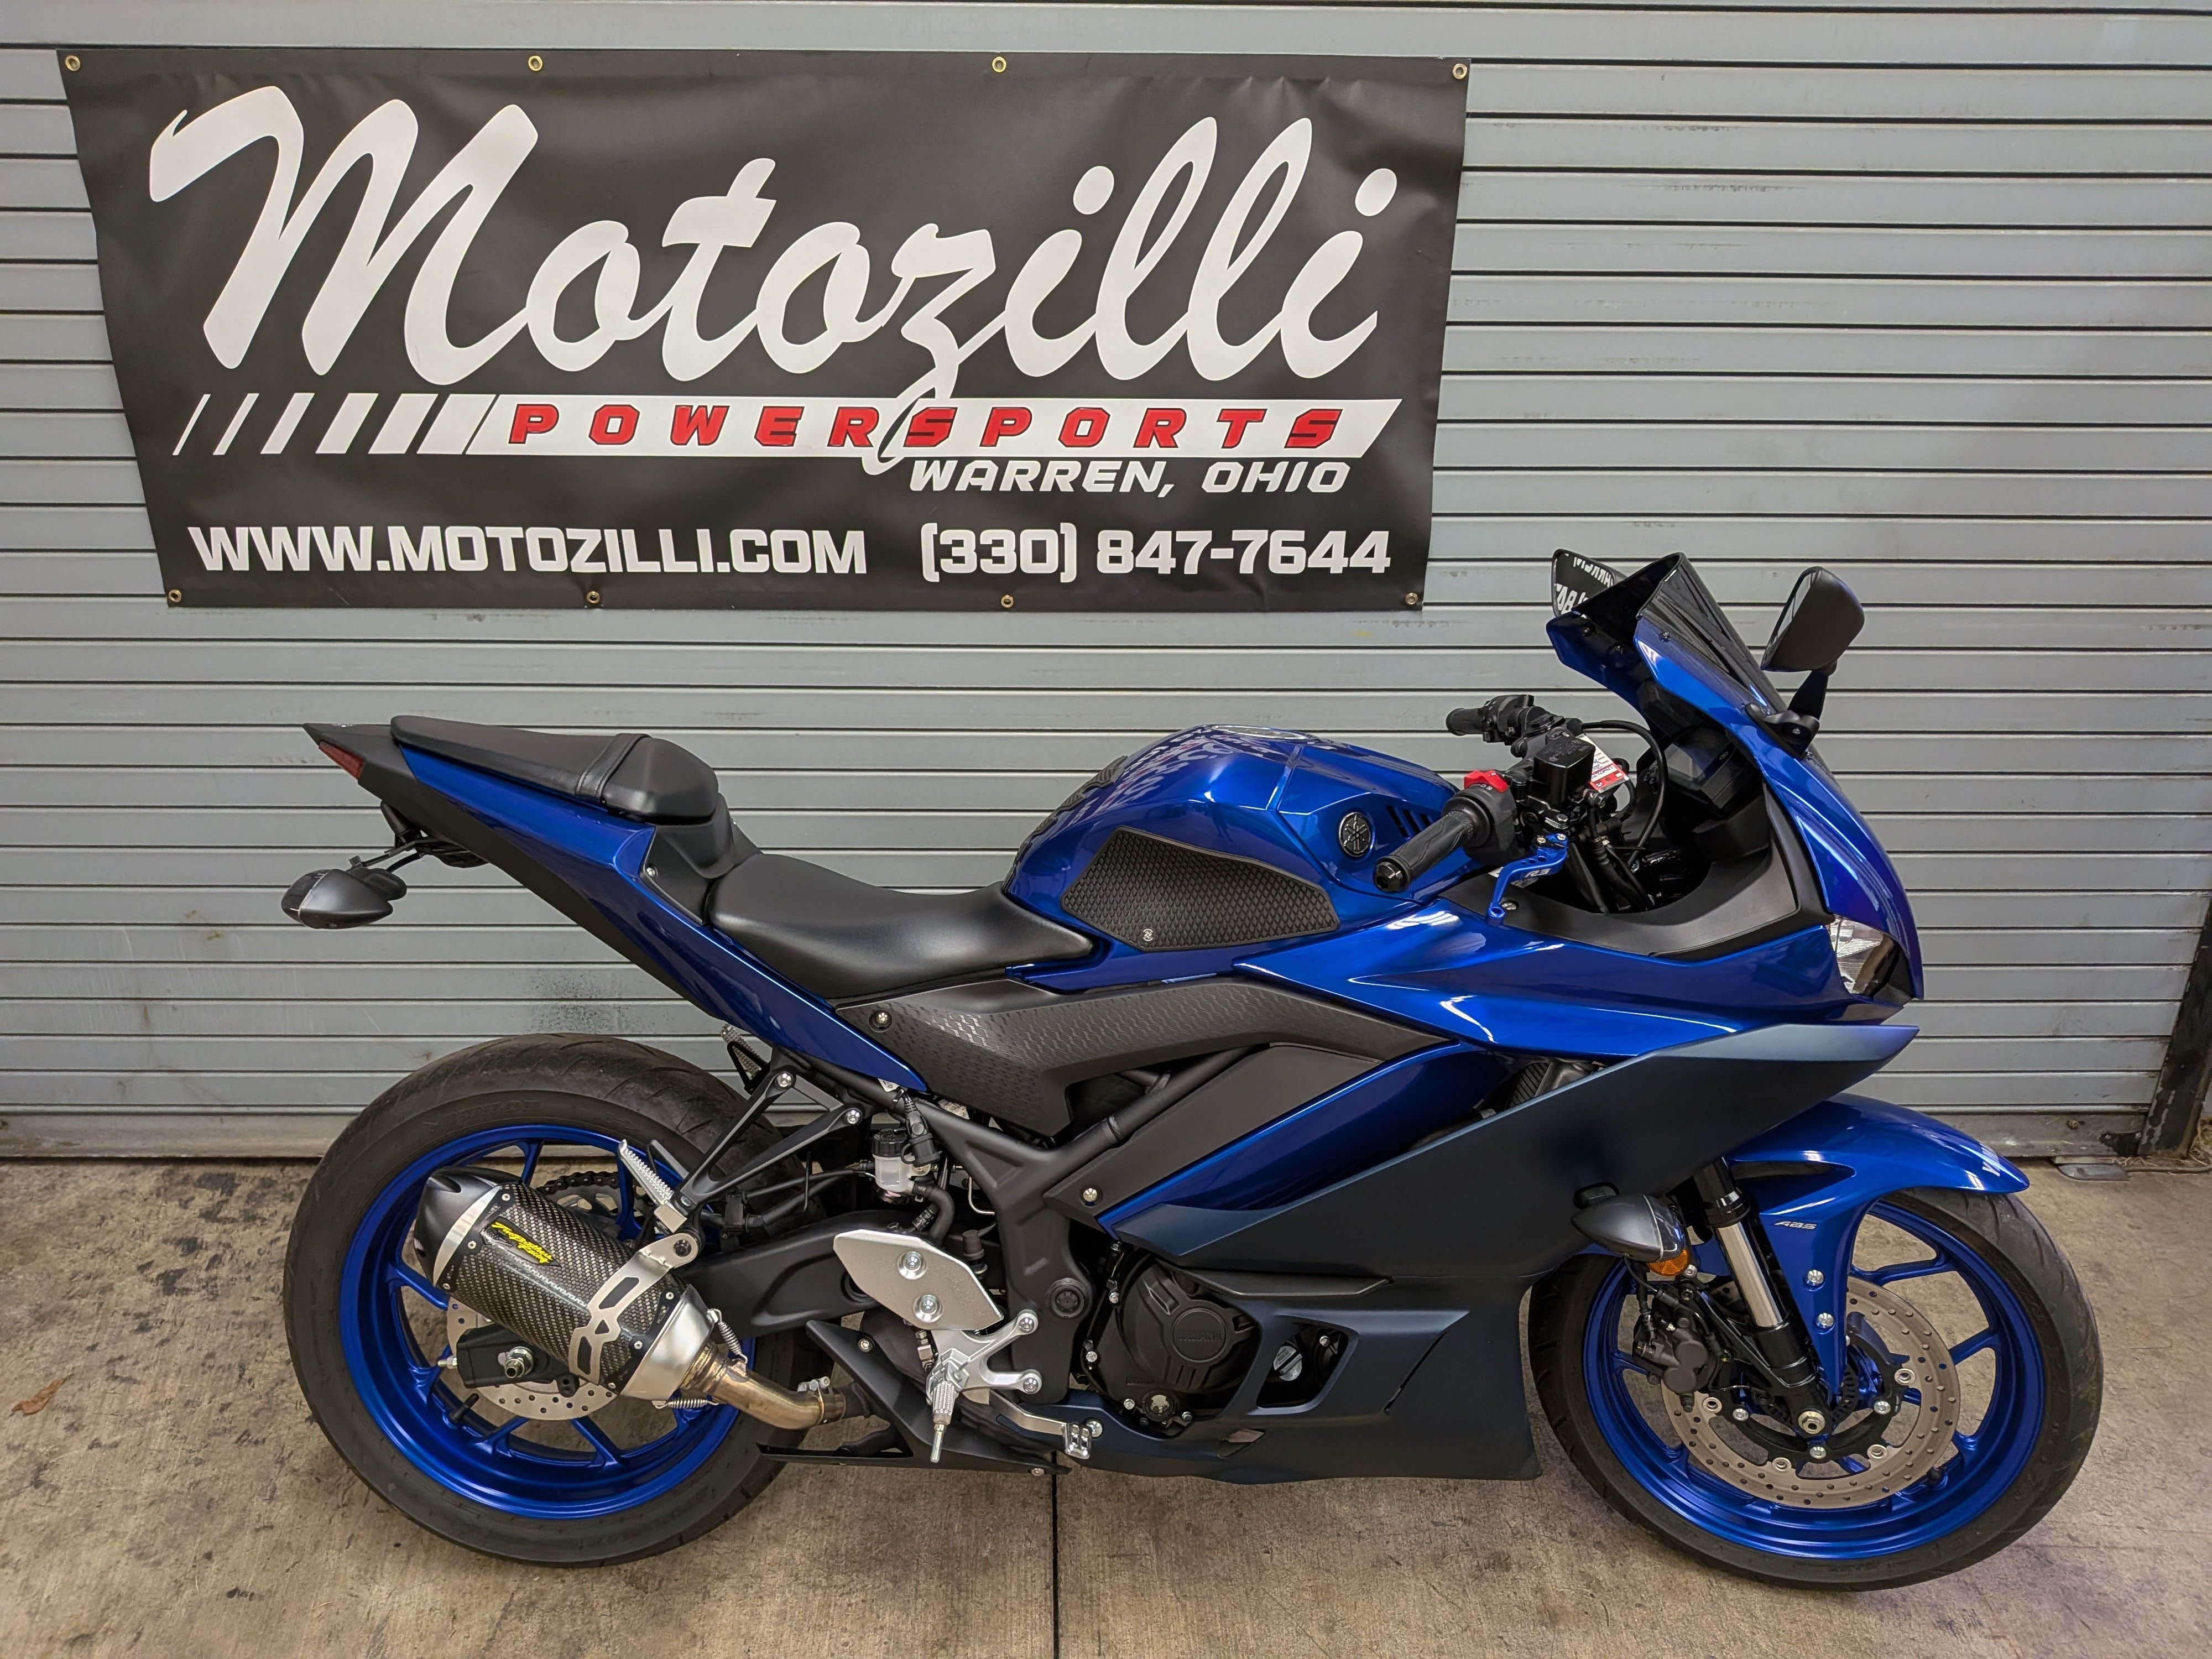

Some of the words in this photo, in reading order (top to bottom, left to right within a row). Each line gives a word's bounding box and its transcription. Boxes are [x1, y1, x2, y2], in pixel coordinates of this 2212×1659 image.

[149, 86, 1397, 475] Motozilli
[508, 404, 1342, 448] POWERSPORTS
[910, 460, 1175, 498] WARREN,
[1202, 461, 1350, 493] OHIO
[187, 525, 867, 574] WWW.MOTOZILLI.COM
[1097, 529, 1391, 575] 847-7644
[1525, 868, 1551, 878] R3
[1774, 1221, 1817, 1229] ABS
